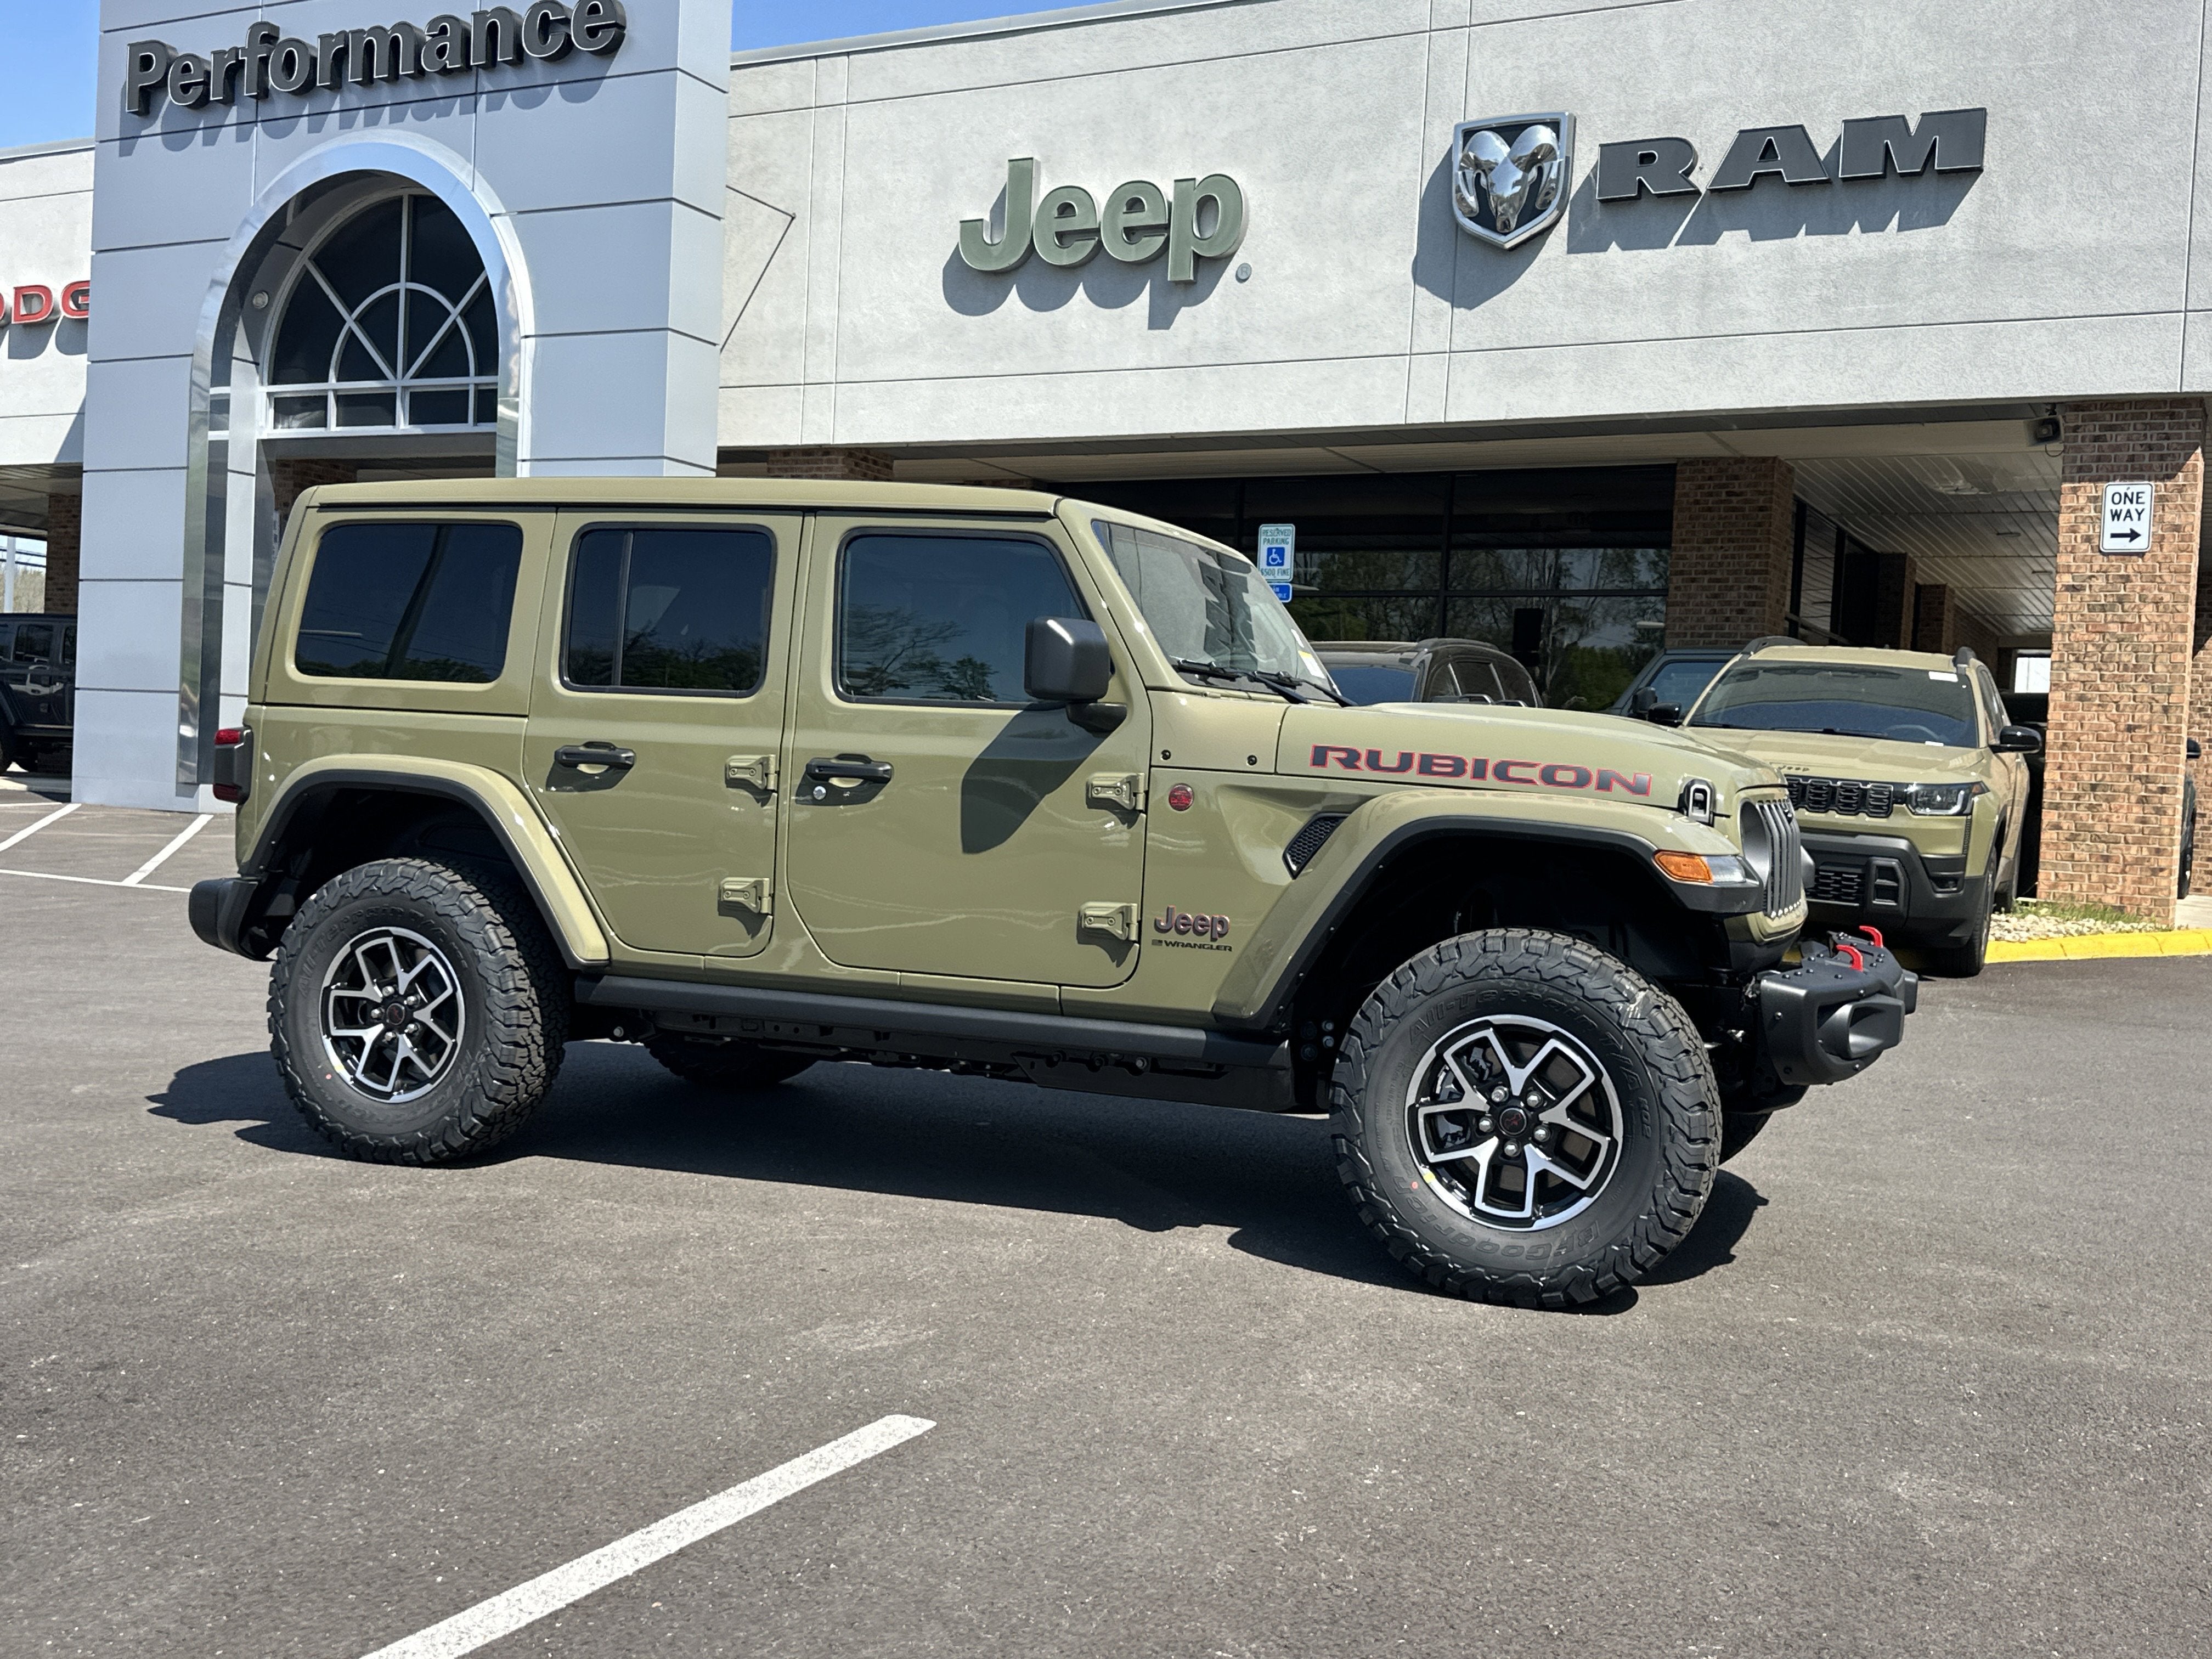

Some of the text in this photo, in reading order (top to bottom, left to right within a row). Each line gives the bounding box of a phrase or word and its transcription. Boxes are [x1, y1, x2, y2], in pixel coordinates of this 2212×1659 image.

[126, 0, 627, 116] Performance
[1596, 107, 1987, 201] RAM
[958, 157, 1249, 283] Jeep
[0, 280, 91, 324] DG
[2110, 508, 2145, 522] WAY
[2111, 491, 2145, 505] ONE
[1262, 528, 1292, 537] RESERVED
[1263, 537, 1290, 545] PARKING
[1277, 568, 1291, 576] FINE
[1310, 744, 1652, 797] RUBICON
[1154, 905, 1231, 940] Jeep
[1164, 940, 1233, 952] WRANGLER
[1393, 1176, 1600, 1261] BFGoodrich
